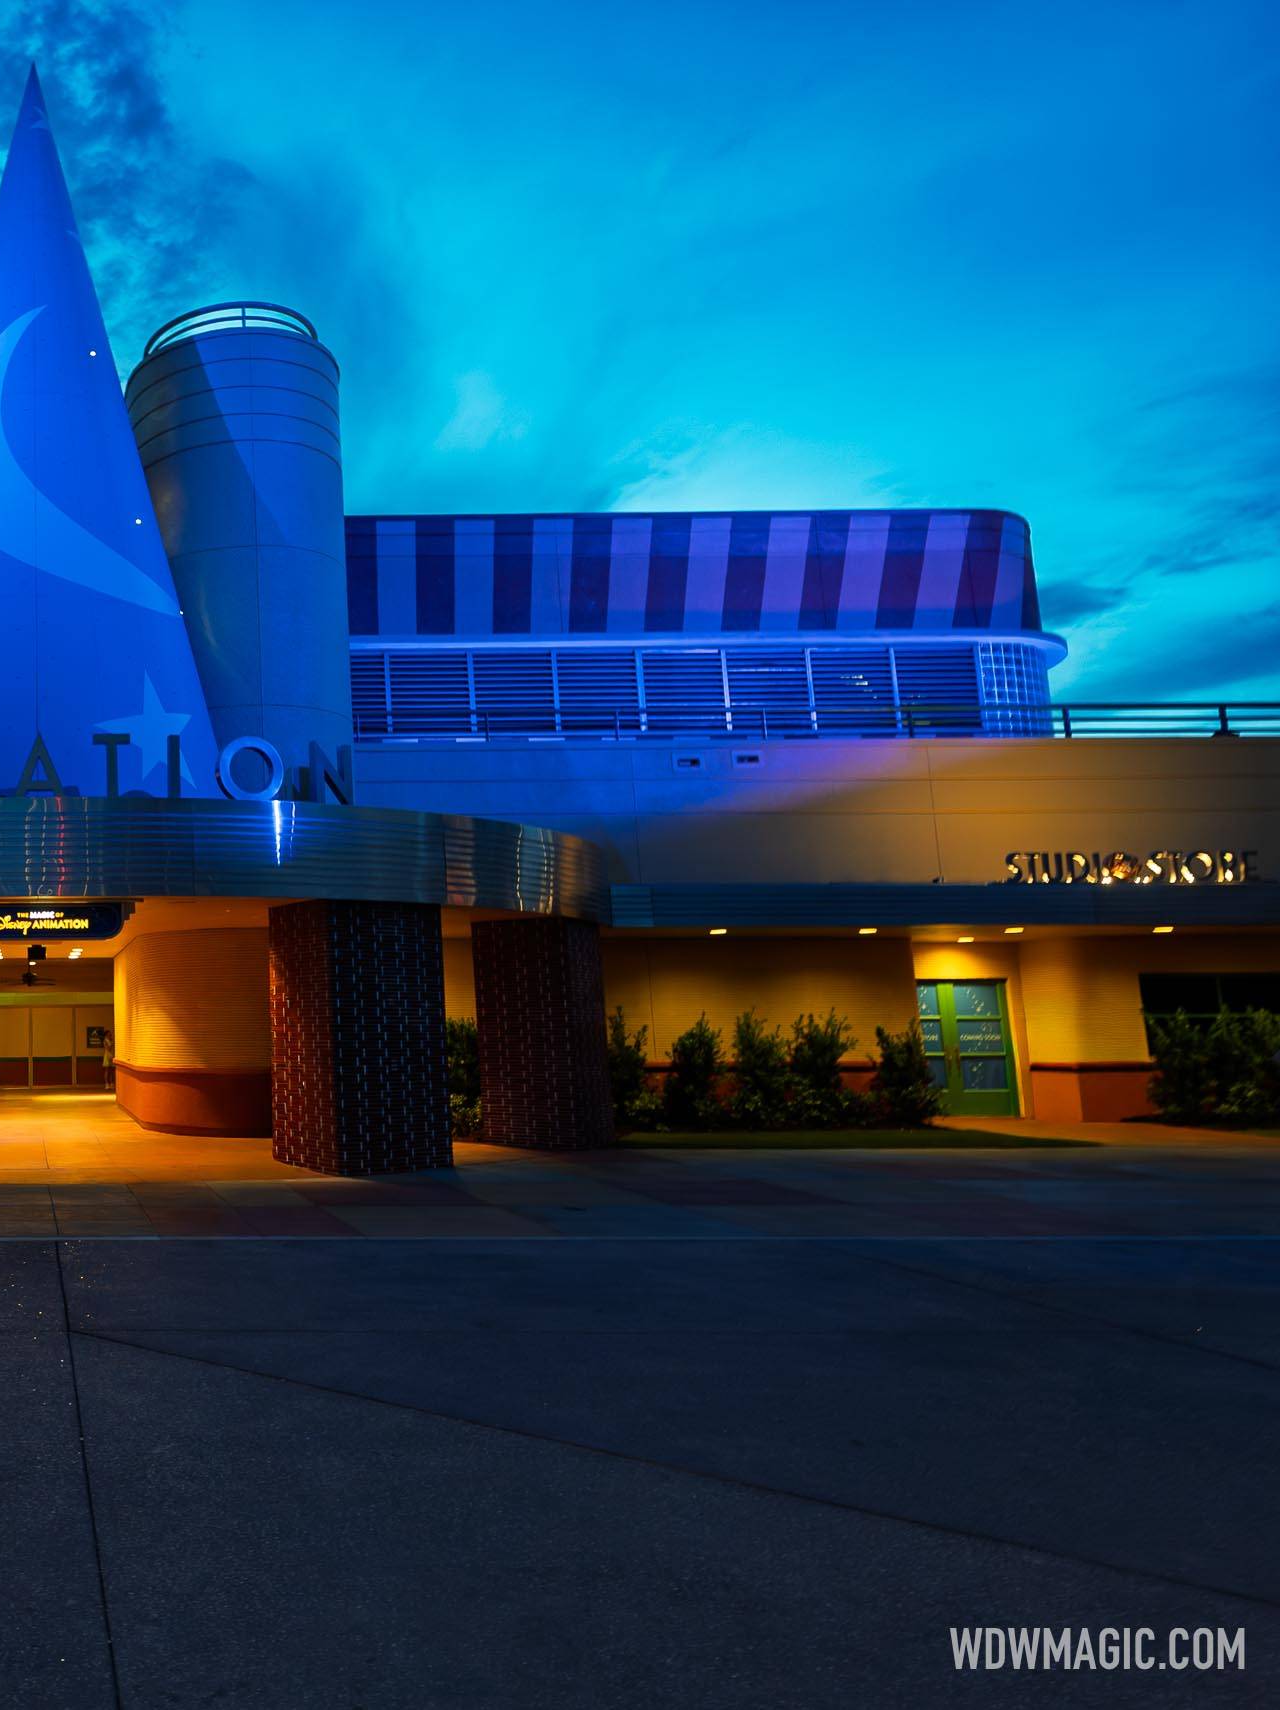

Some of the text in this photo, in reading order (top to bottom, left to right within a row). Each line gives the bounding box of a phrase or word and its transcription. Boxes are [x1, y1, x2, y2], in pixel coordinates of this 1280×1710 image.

[1143, 850, 1259, 885] STORE
[30, 910, 55, 919] MAGIC
[32, 919, 89, 929] ANIMATION
